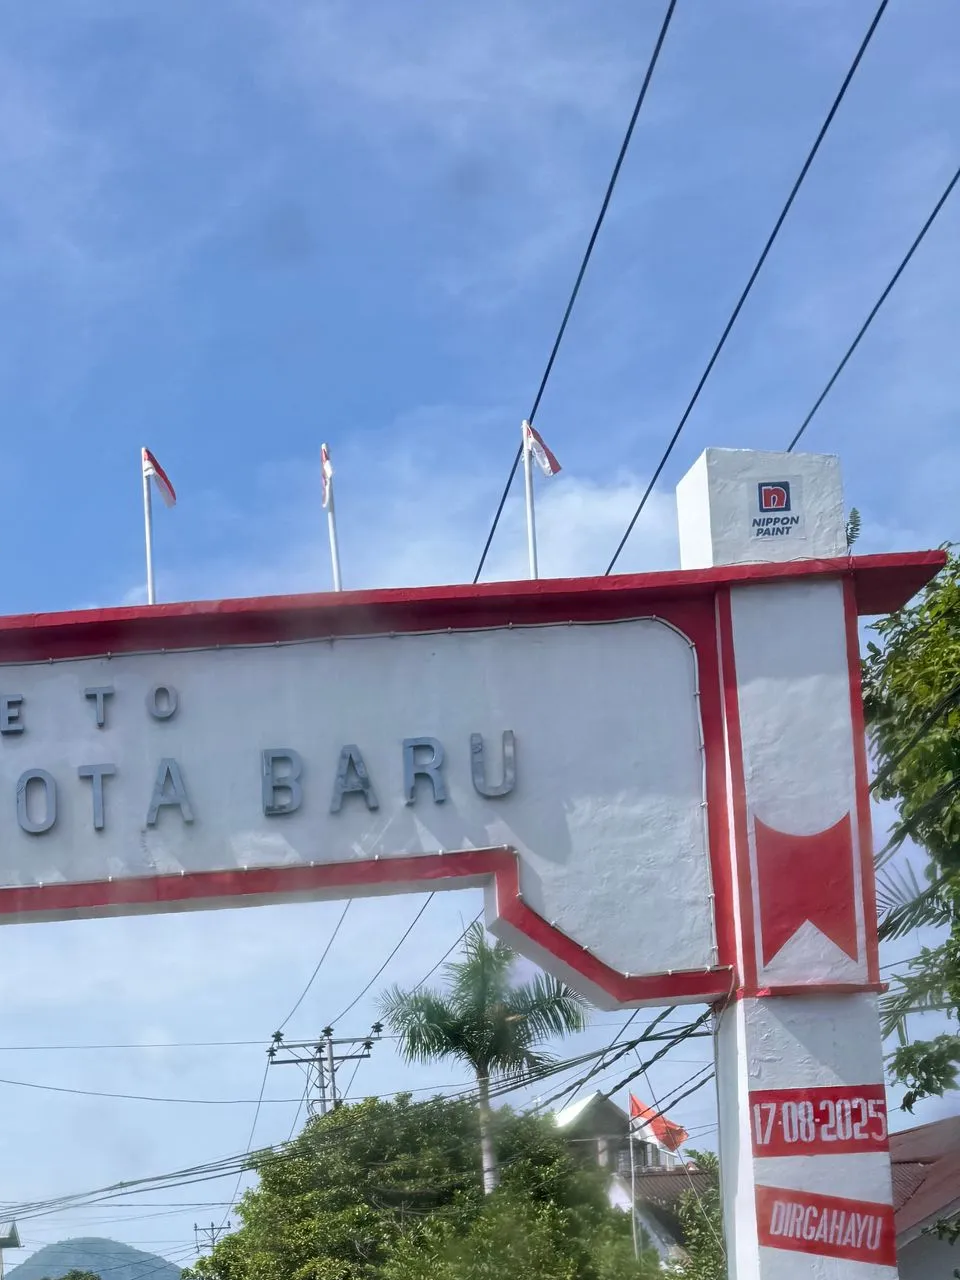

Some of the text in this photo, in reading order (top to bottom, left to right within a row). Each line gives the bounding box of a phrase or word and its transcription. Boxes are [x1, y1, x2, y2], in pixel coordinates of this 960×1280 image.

[752, 516, 800, 528] NIPPON
[756, 526, 792, 537] PAINT
[85, 684, 179, 728] TO
[261, 729, 517, 817] BARU
